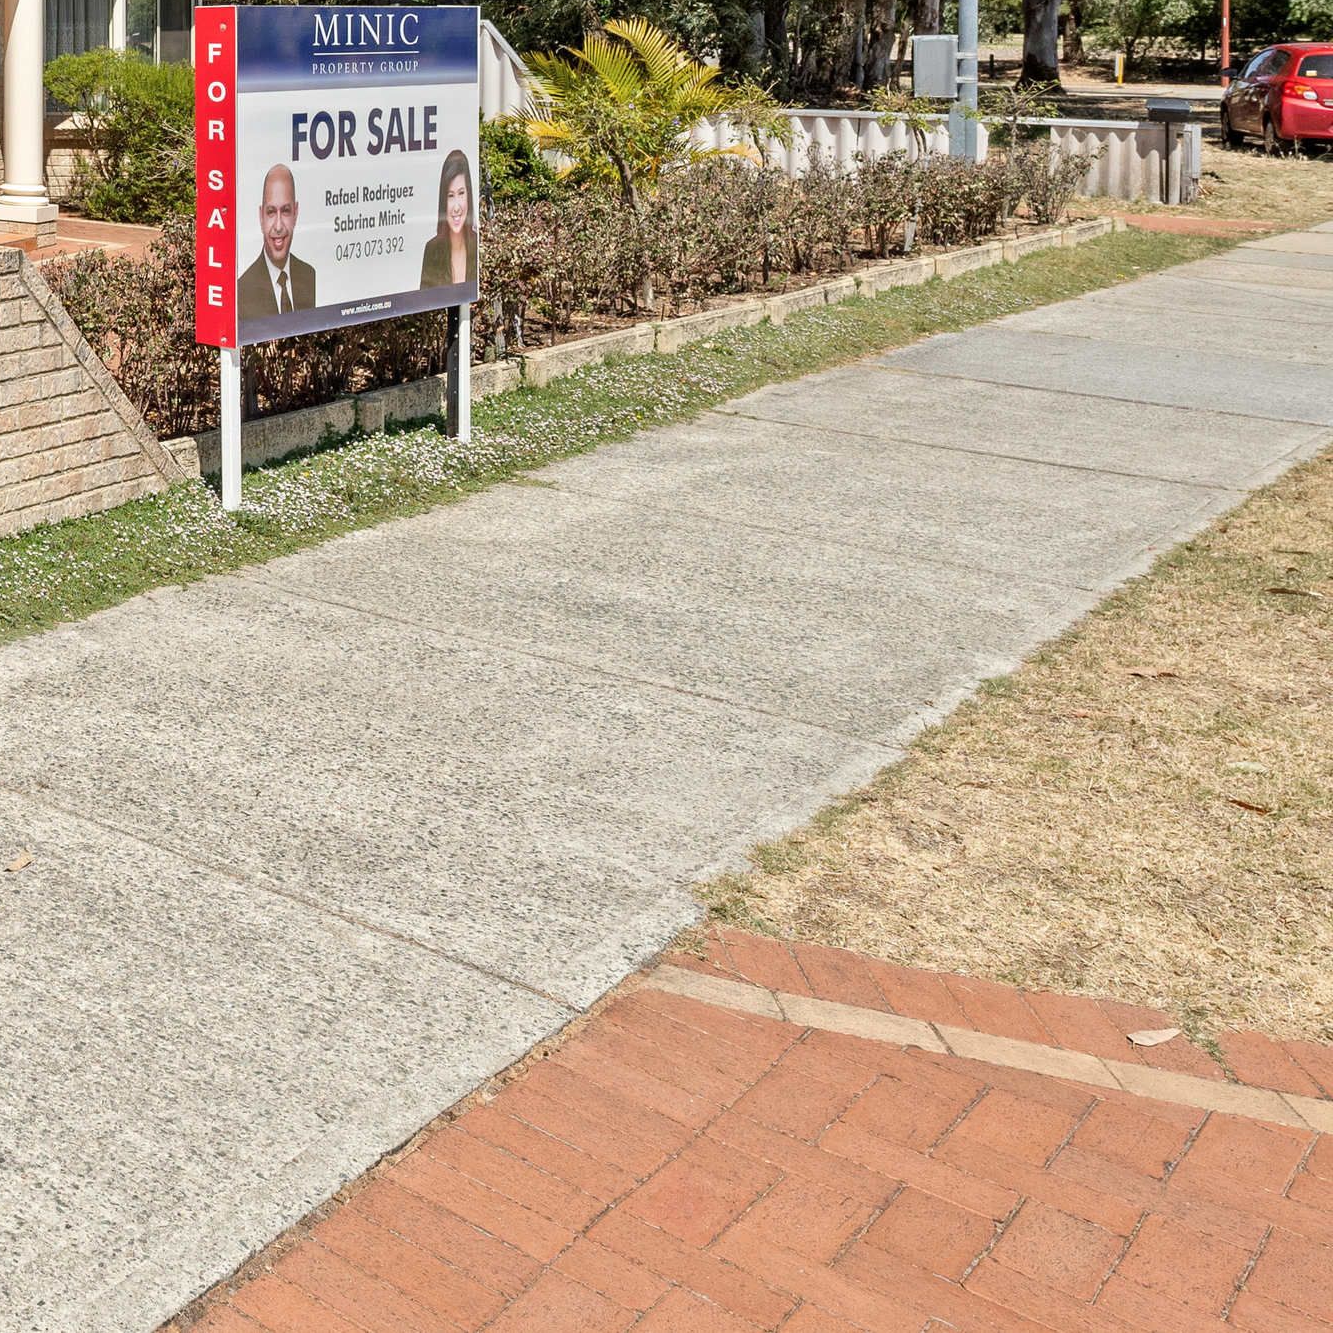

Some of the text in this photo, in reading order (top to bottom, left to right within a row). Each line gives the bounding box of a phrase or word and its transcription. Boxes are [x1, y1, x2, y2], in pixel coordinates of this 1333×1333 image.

[312, 13, 420, 47] MINIC
[312, 60, 420, 75] PROPERTY GROUP
[292, 105, 438, 162] FOR SALE
[207, 42, 227, 307] FOR SALE
[325, 183, 414, 206] Rafael Rodriguez
[334, 208, 406, 233] Sabrina Minic
[335, 235, 404, 261] 0473 073 392
[341, 300, 392, 316] www.minic.com.au
